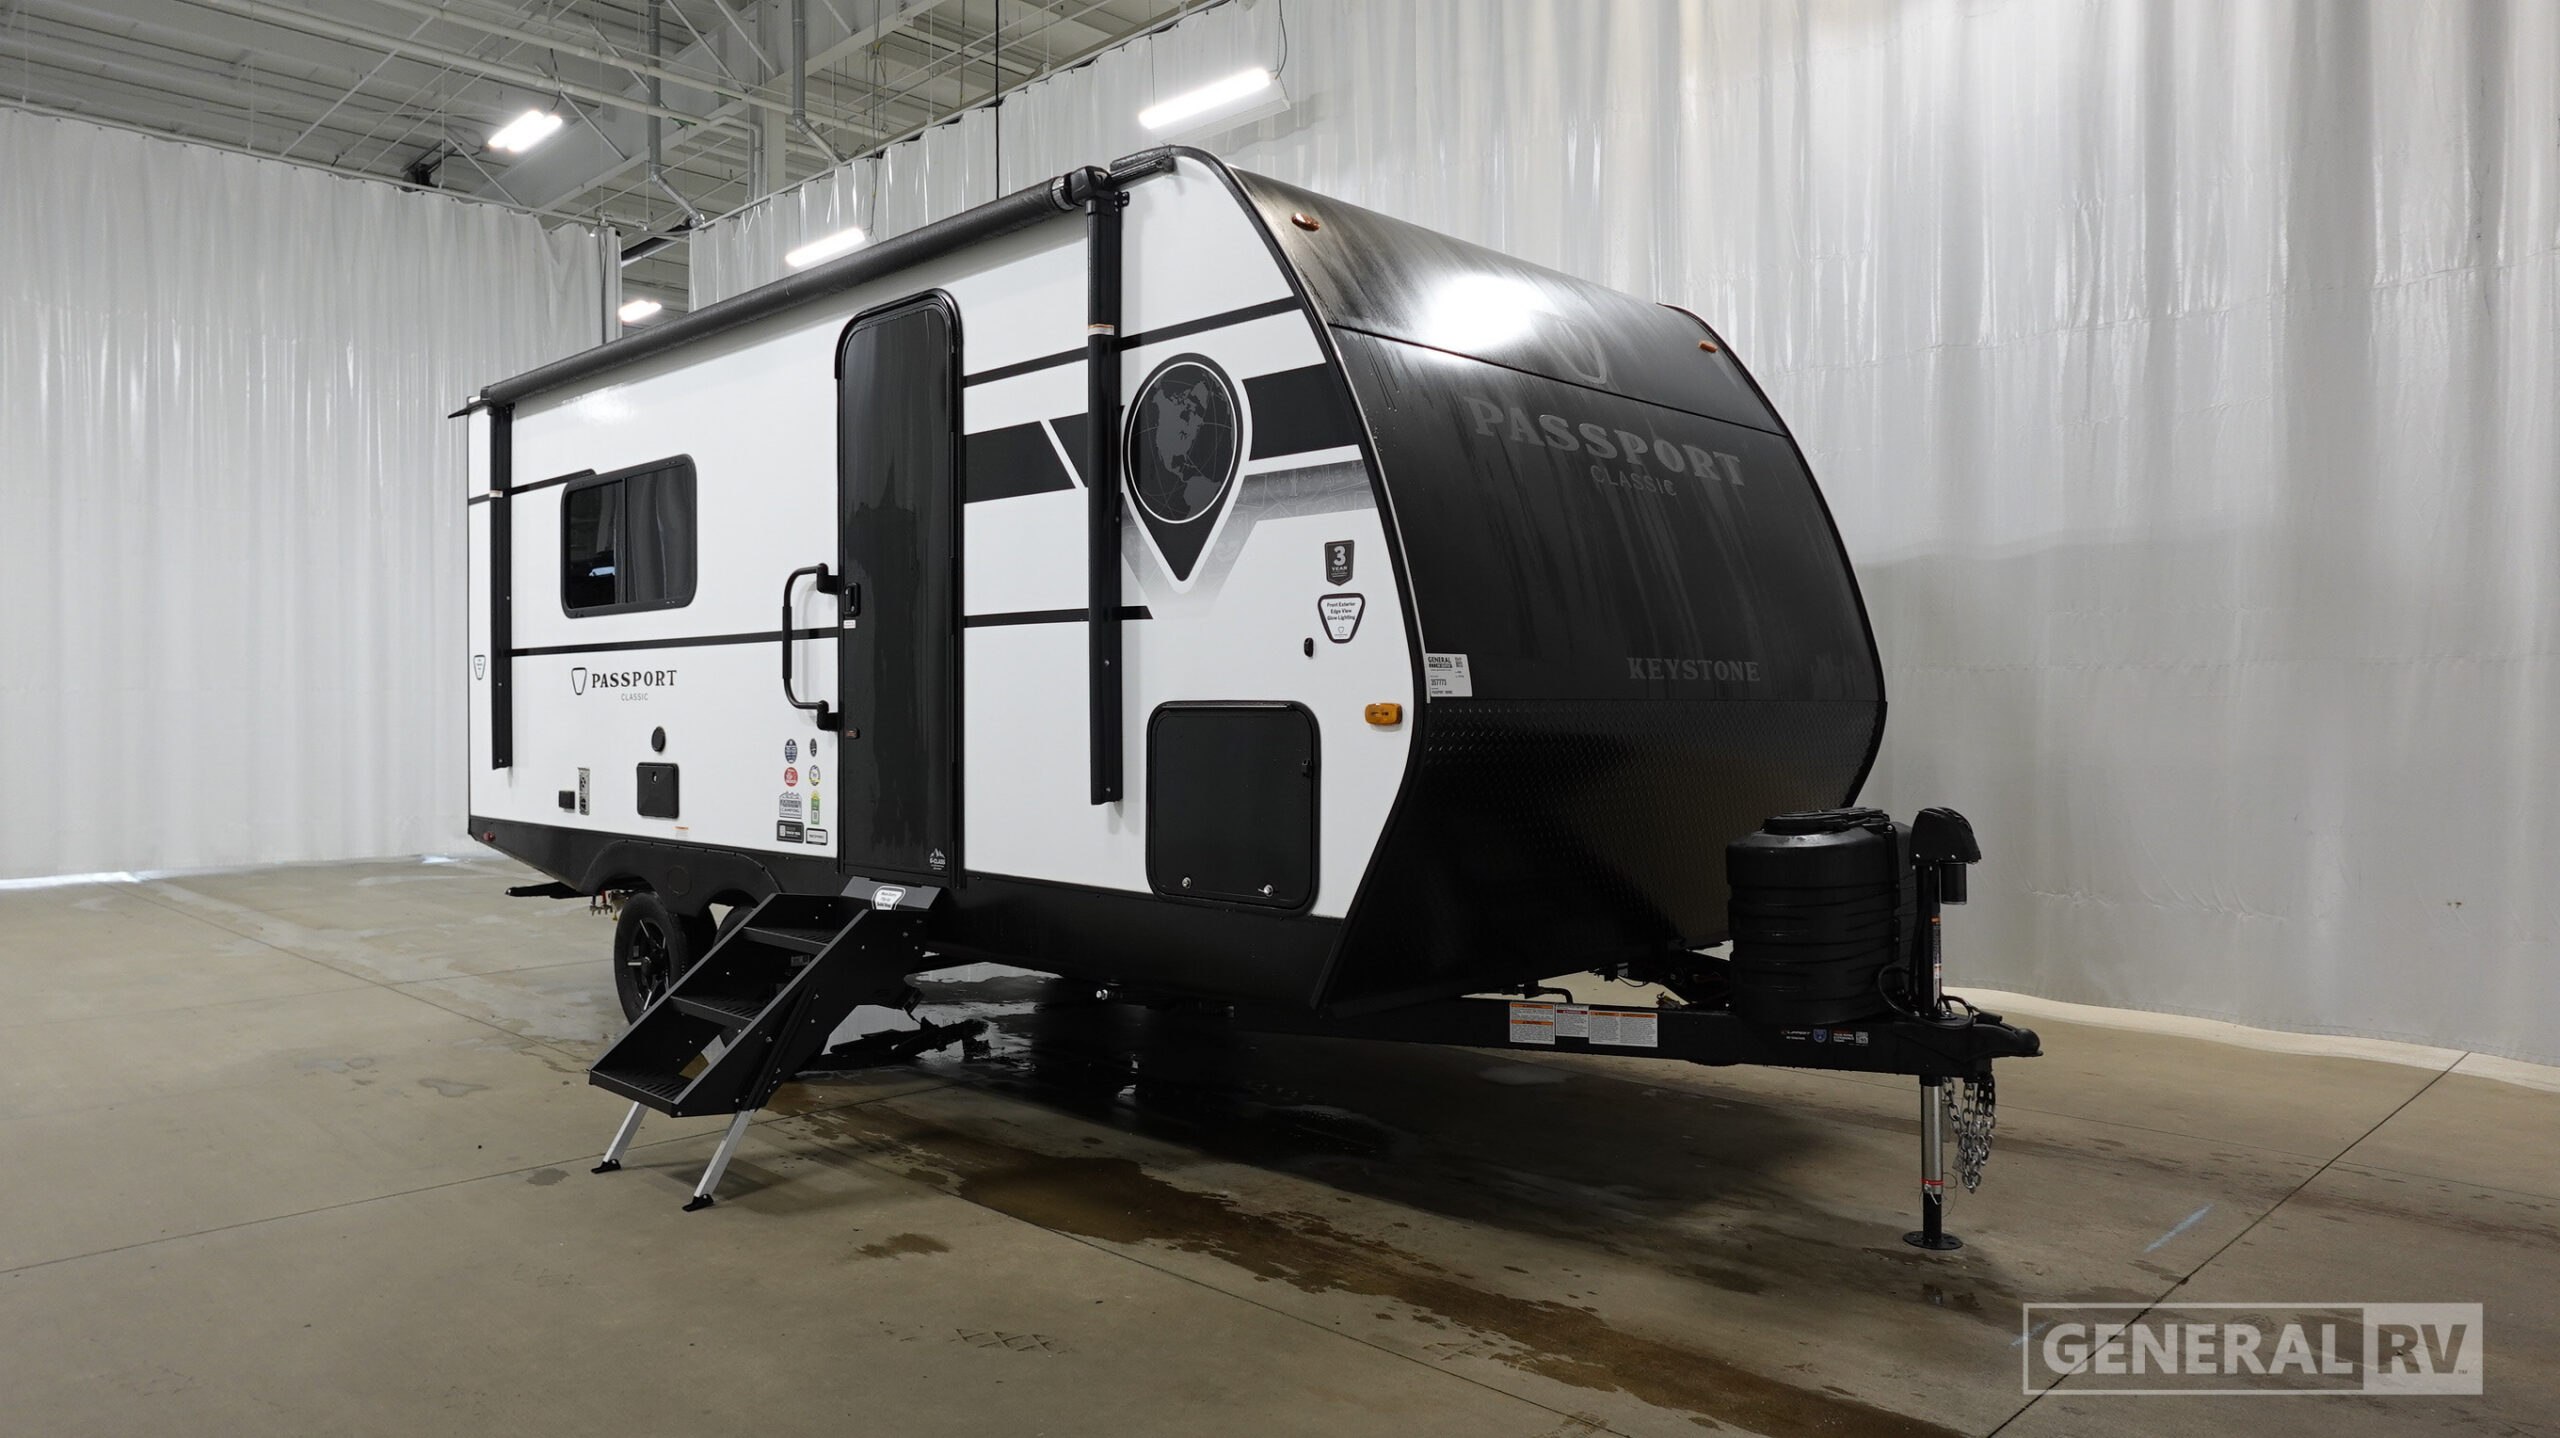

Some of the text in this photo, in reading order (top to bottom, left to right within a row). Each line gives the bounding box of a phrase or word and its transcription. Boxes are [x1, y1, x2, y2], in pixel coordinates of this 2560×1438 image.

[1467, 397, 1744, 486] PASSPORT
[1590, 465, 1677, 496] CLASSIC
[1333, 545, 1346, 566] 3
[592, 670, 677, 688] PASSPORT
[1626, 657, 1760, 682] KEYSTONE
[621, 693, 648, 701] CLASSIC
